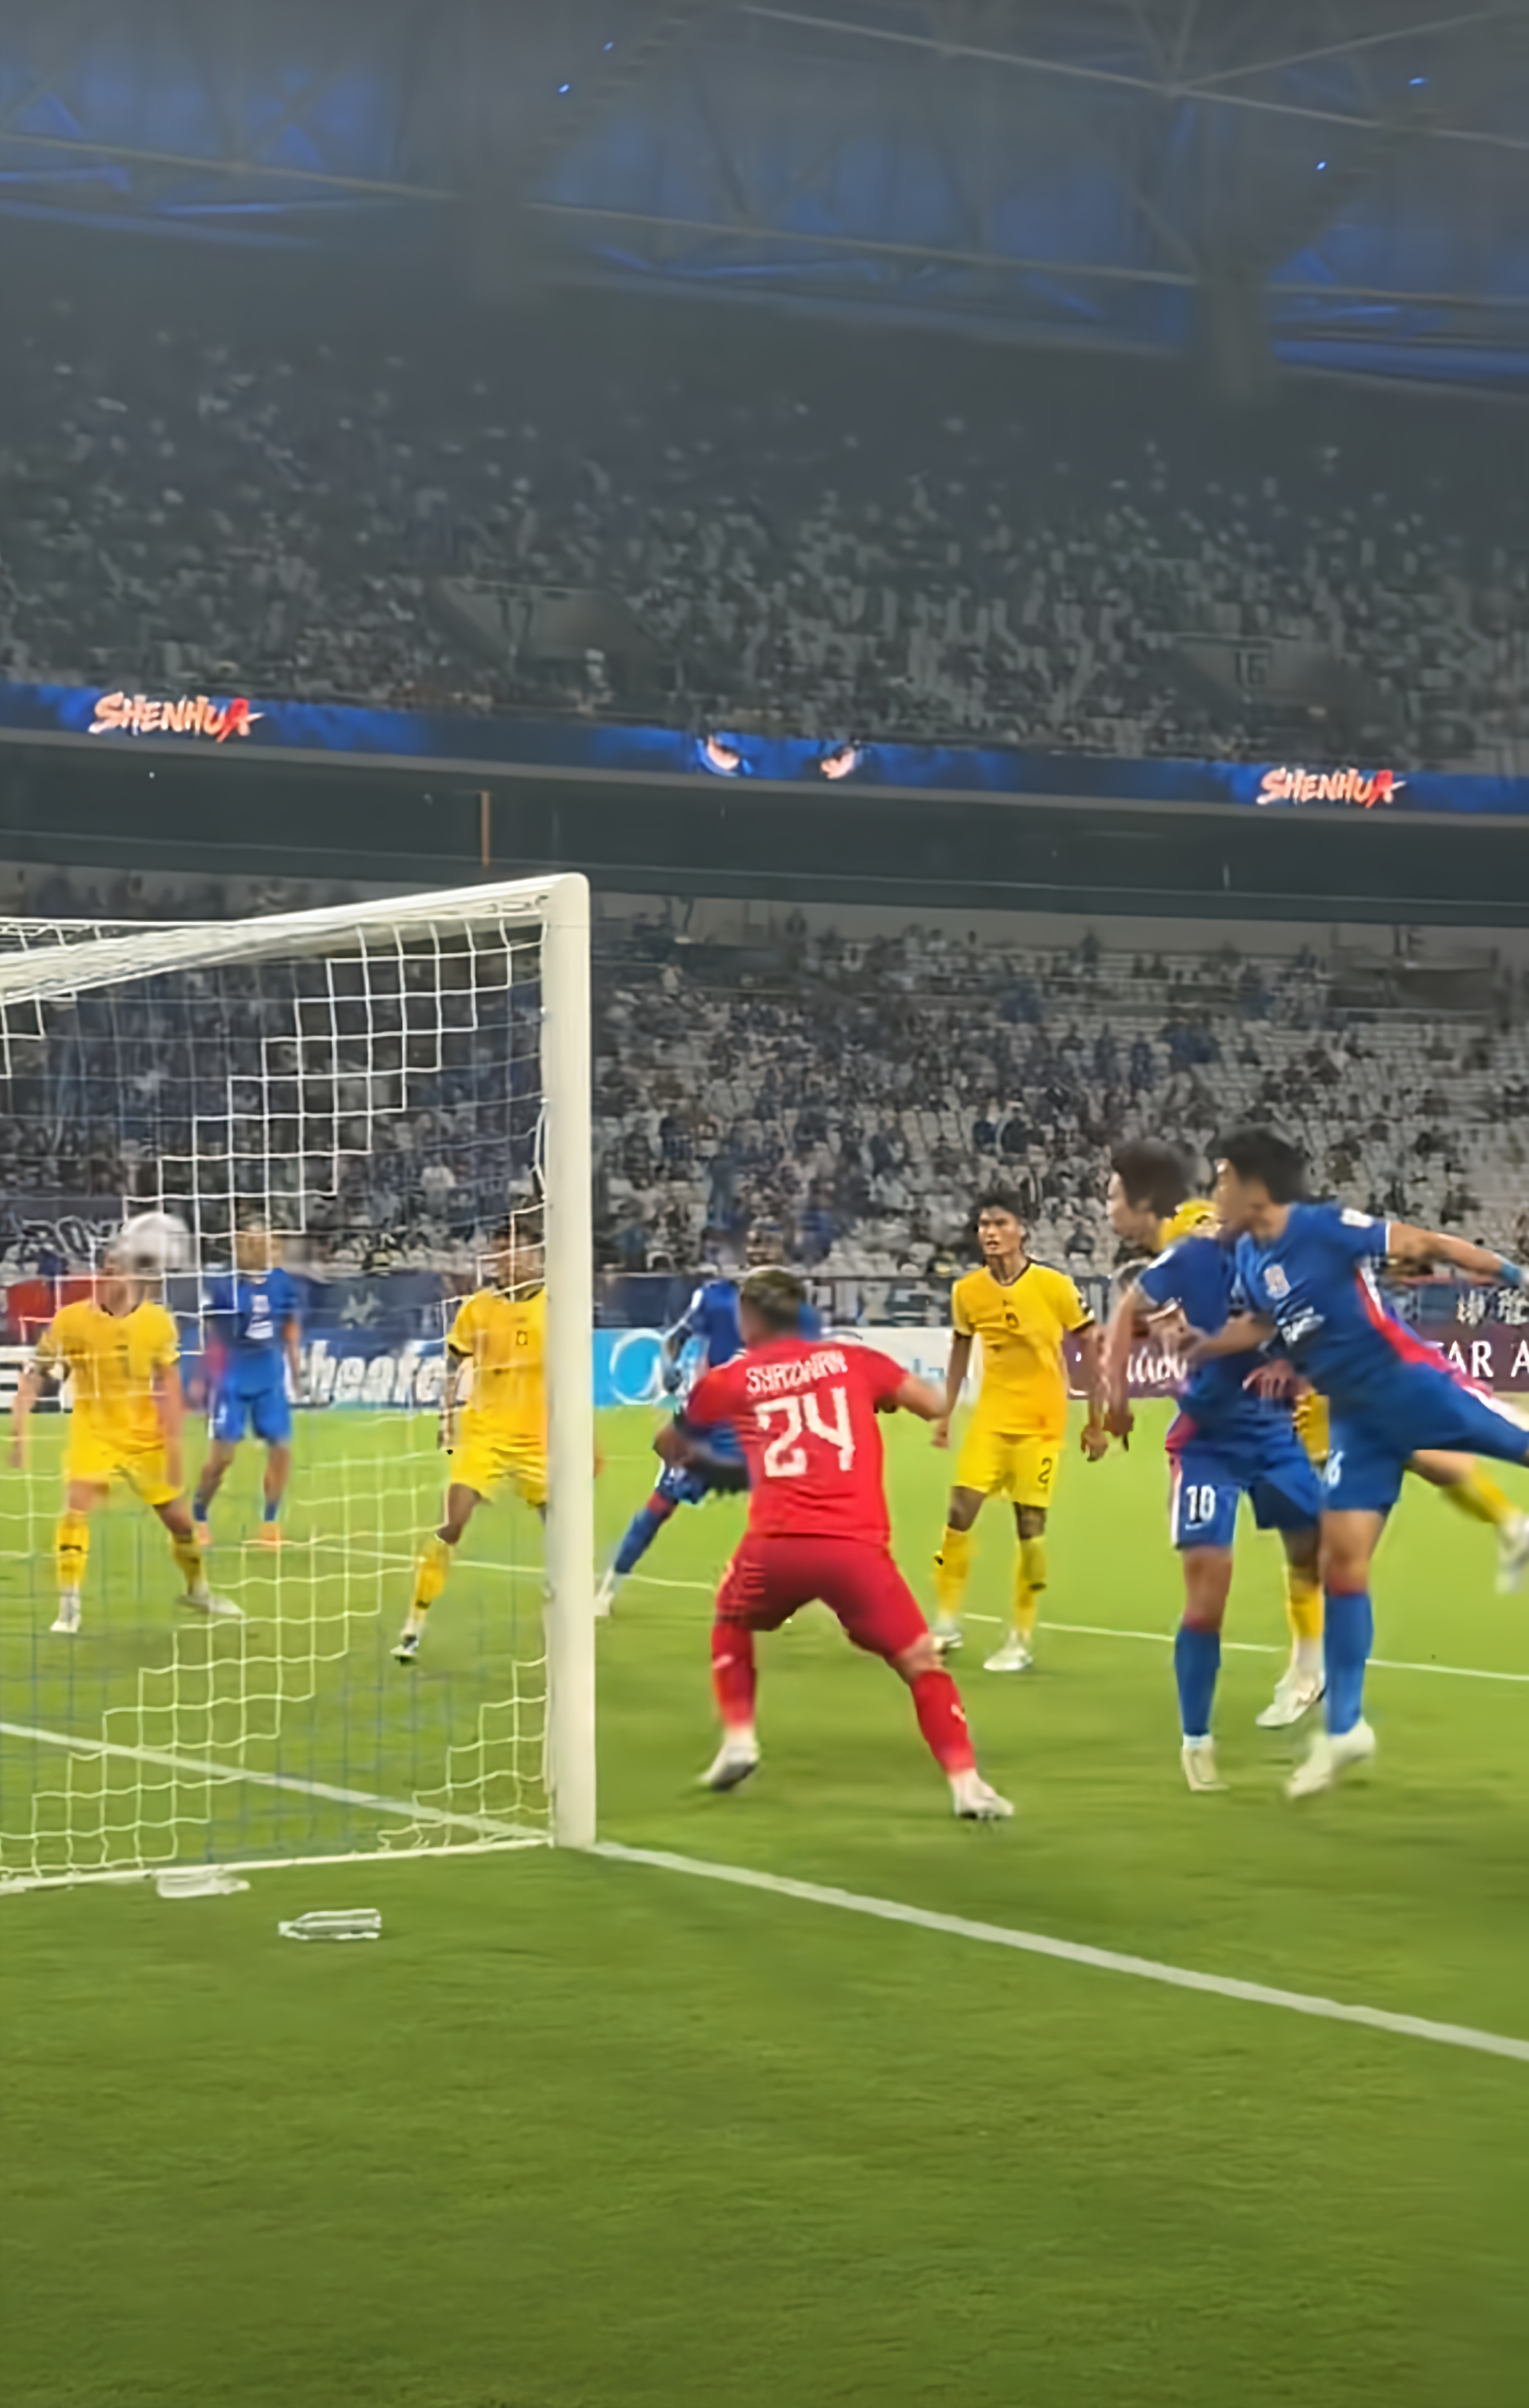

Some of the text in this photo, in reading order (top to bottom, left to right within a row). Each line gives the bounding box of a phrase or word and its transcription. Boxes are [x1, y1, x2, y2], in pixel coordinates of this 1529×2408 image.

[89, 692, 265, 743] SHENHUA
[1256, 766, 1406, 808] SHENHUA
[755, 1386, 856, 1478] 24
